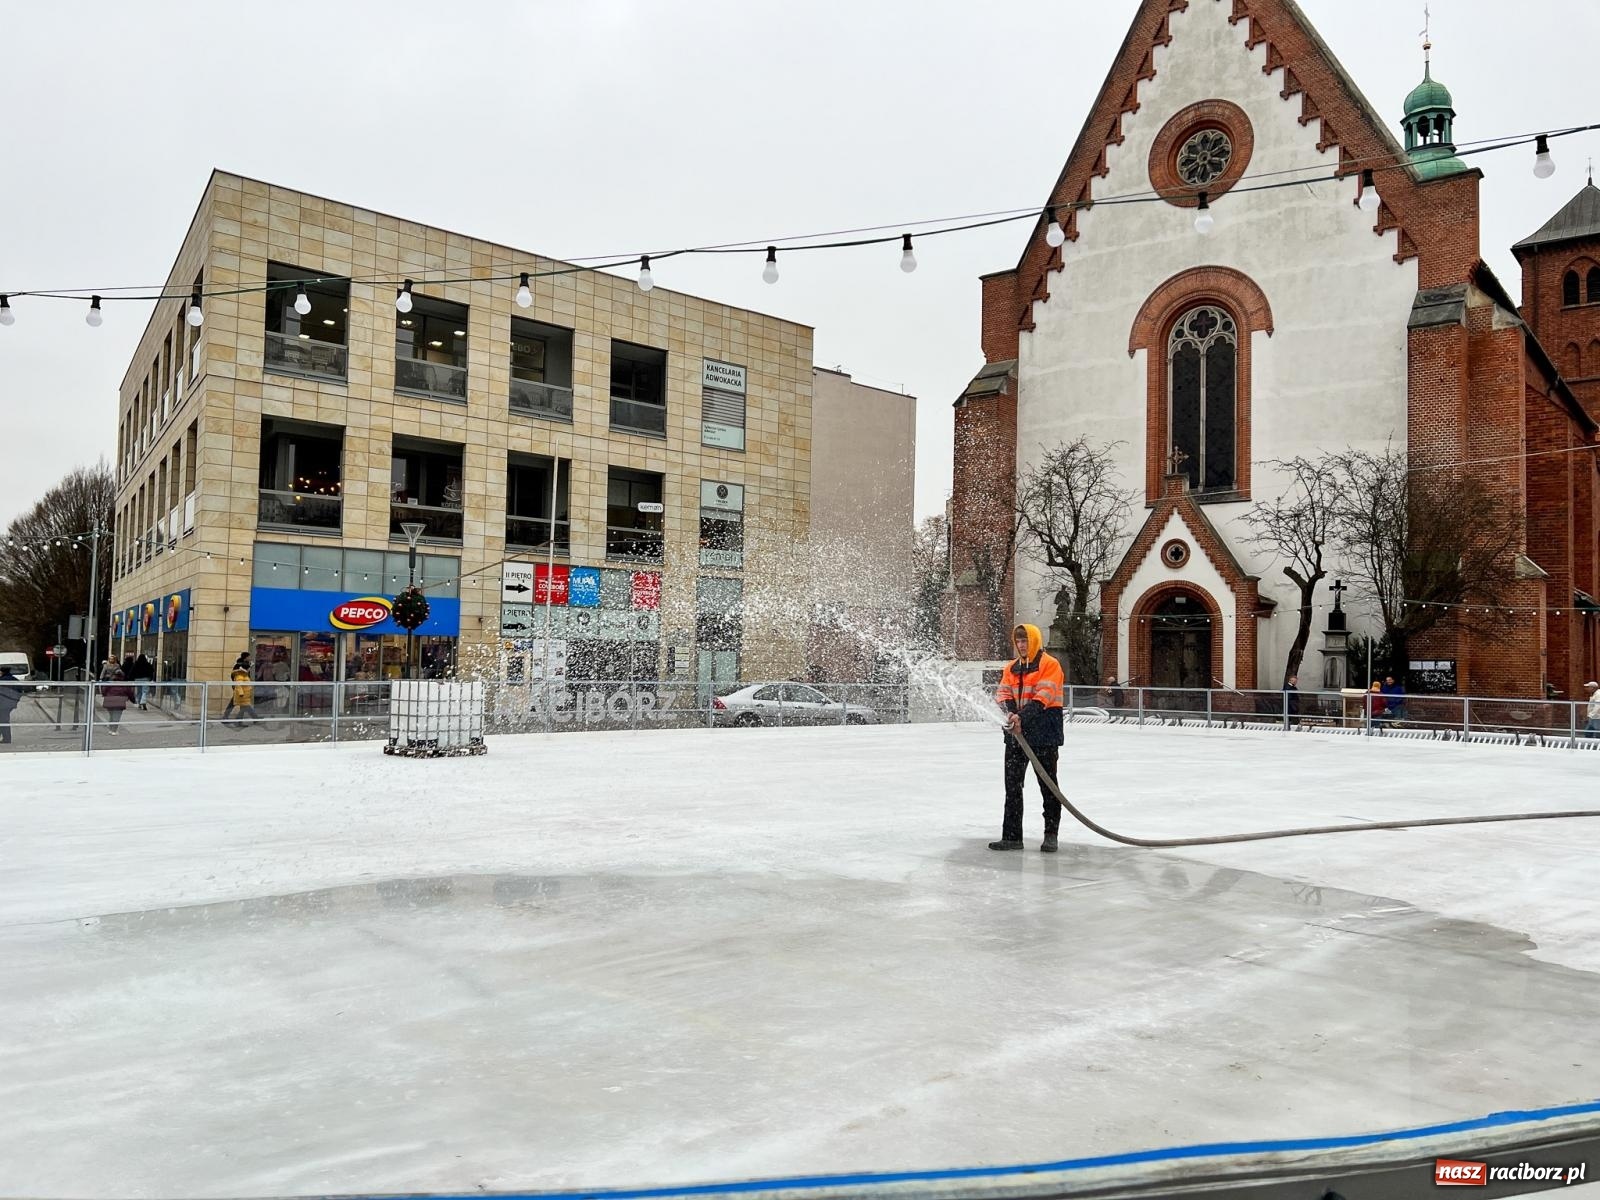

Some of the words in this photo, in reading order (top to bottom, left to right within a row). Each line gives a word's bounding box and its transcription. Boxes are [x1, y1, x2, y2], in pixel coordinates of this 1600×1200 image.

[706, 363, 742, 378] KANCELARIA
[705, 373, 742, 388] ADWOKACKA
[511, 572, 532, 581] PIĘTRO
[340, 607, 384, 620] PEPCO
